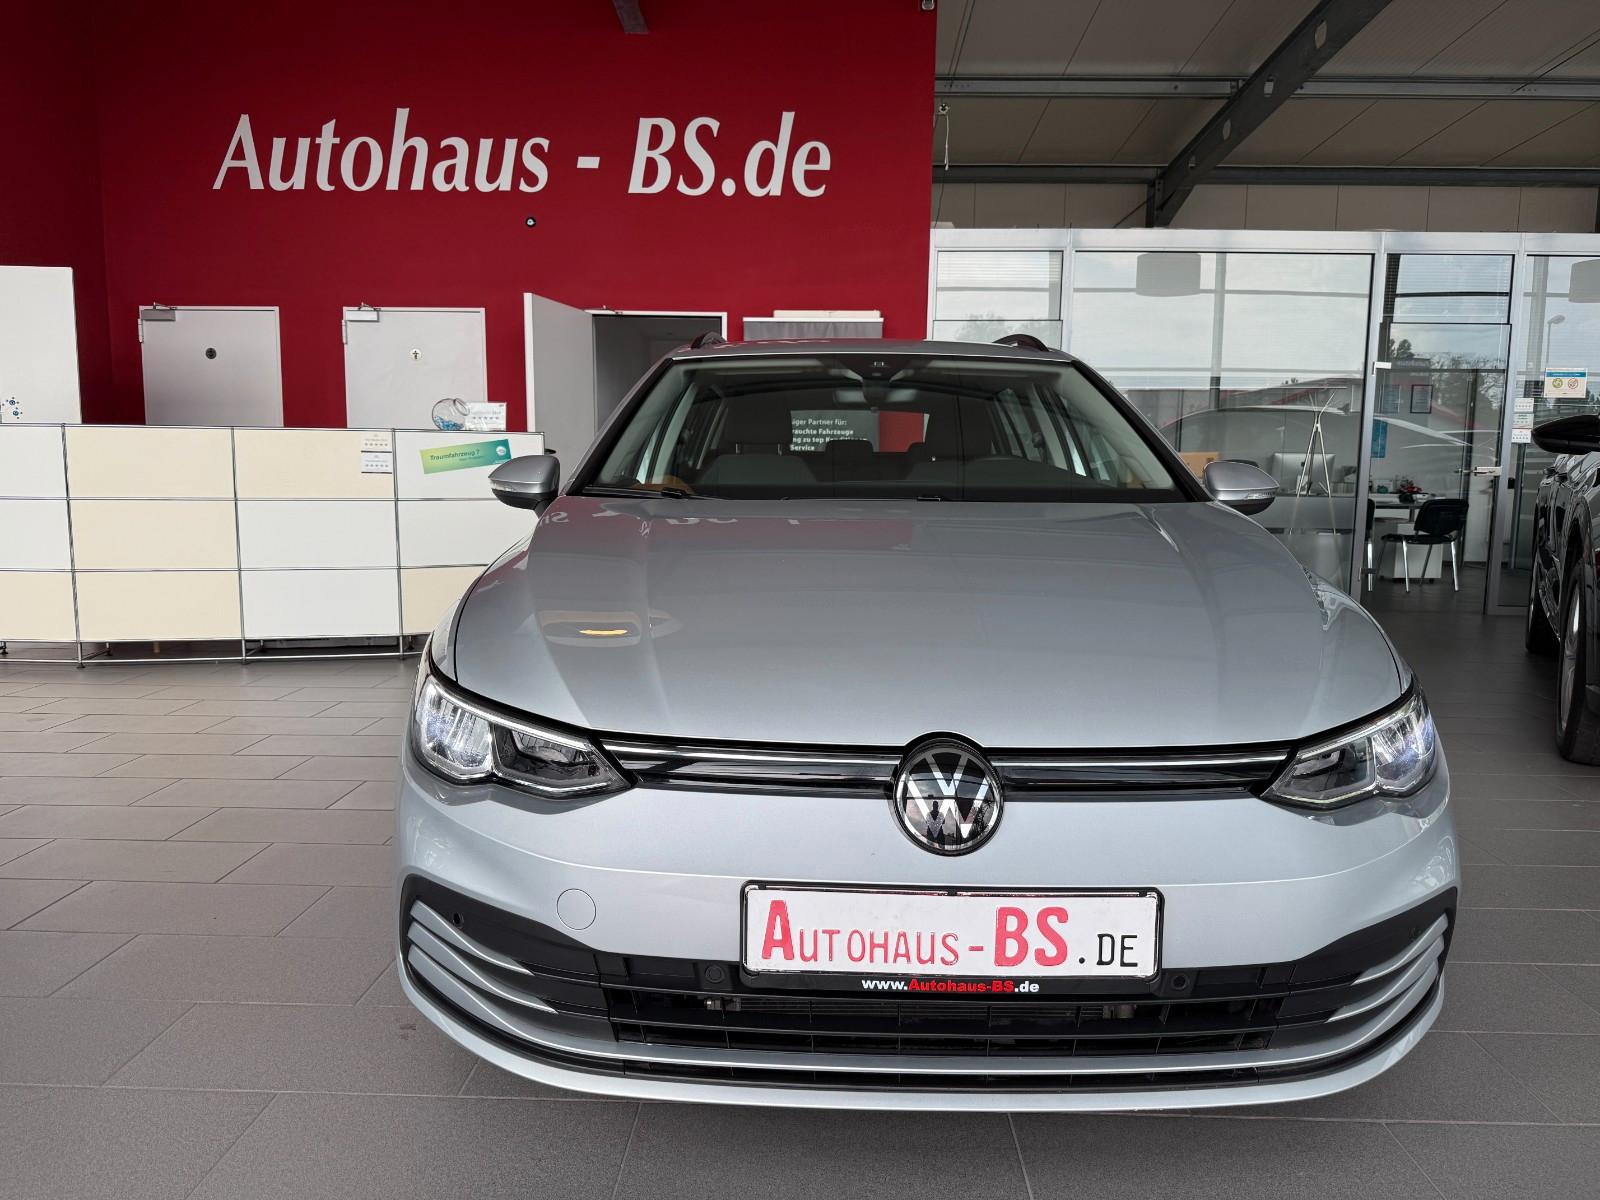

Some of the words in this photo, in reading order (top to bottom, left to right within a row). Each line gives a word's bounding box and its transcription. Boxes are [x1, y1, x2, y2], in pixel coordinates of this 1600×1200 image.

[212, 107, 550, 193] Autohaus
[577, 156, 601, 169] -
[627, 111, 832, 198] BS.de
[818, 428, 854, 436] Fahrzeuge
[430, 450, 476, 461] Traumfahrzeug
[861, 977, 1040, 994] www.Autohaus-BS.de
